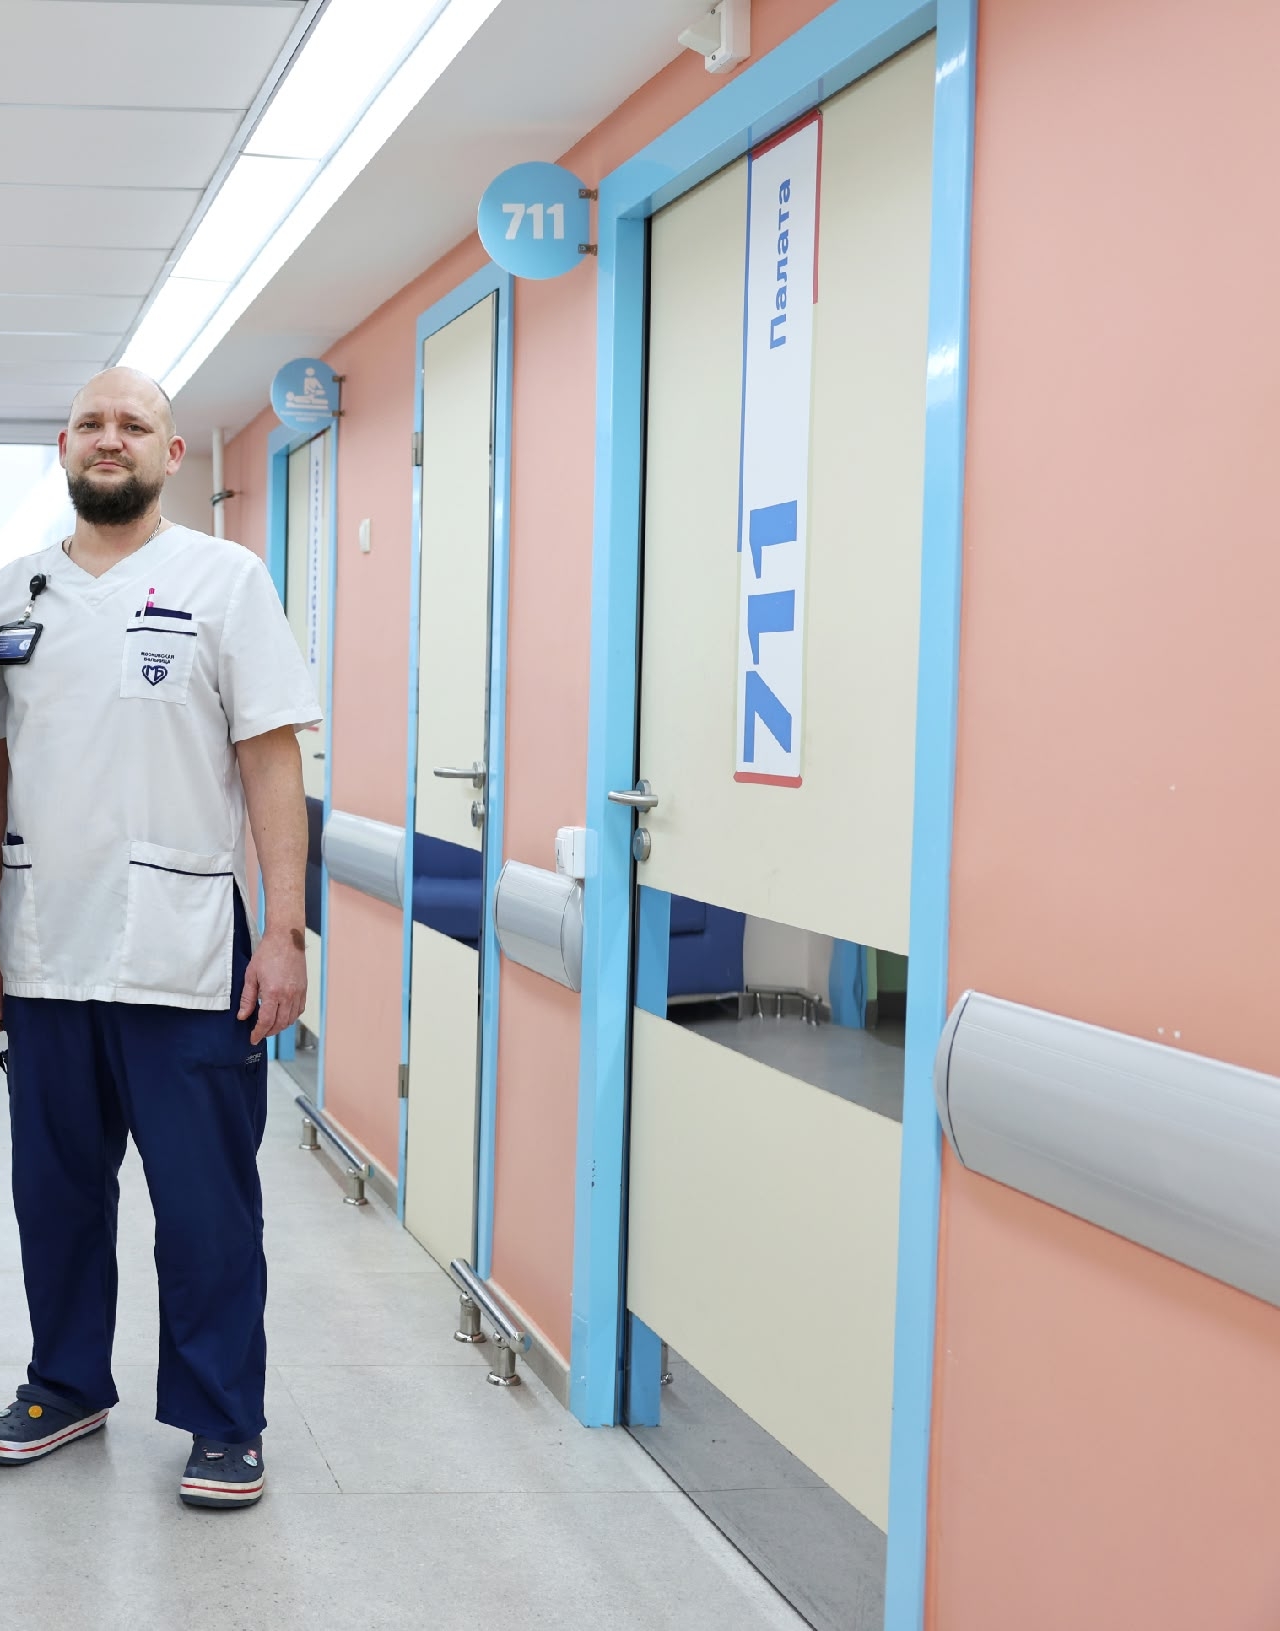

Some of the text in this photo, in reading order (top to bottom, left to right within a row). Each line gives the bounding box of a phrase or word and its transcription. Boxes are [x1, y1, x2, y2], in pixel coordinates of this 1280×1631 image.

[502, 203, 565, 240] 711
[743, 178, 798, 763] 711 Палата
